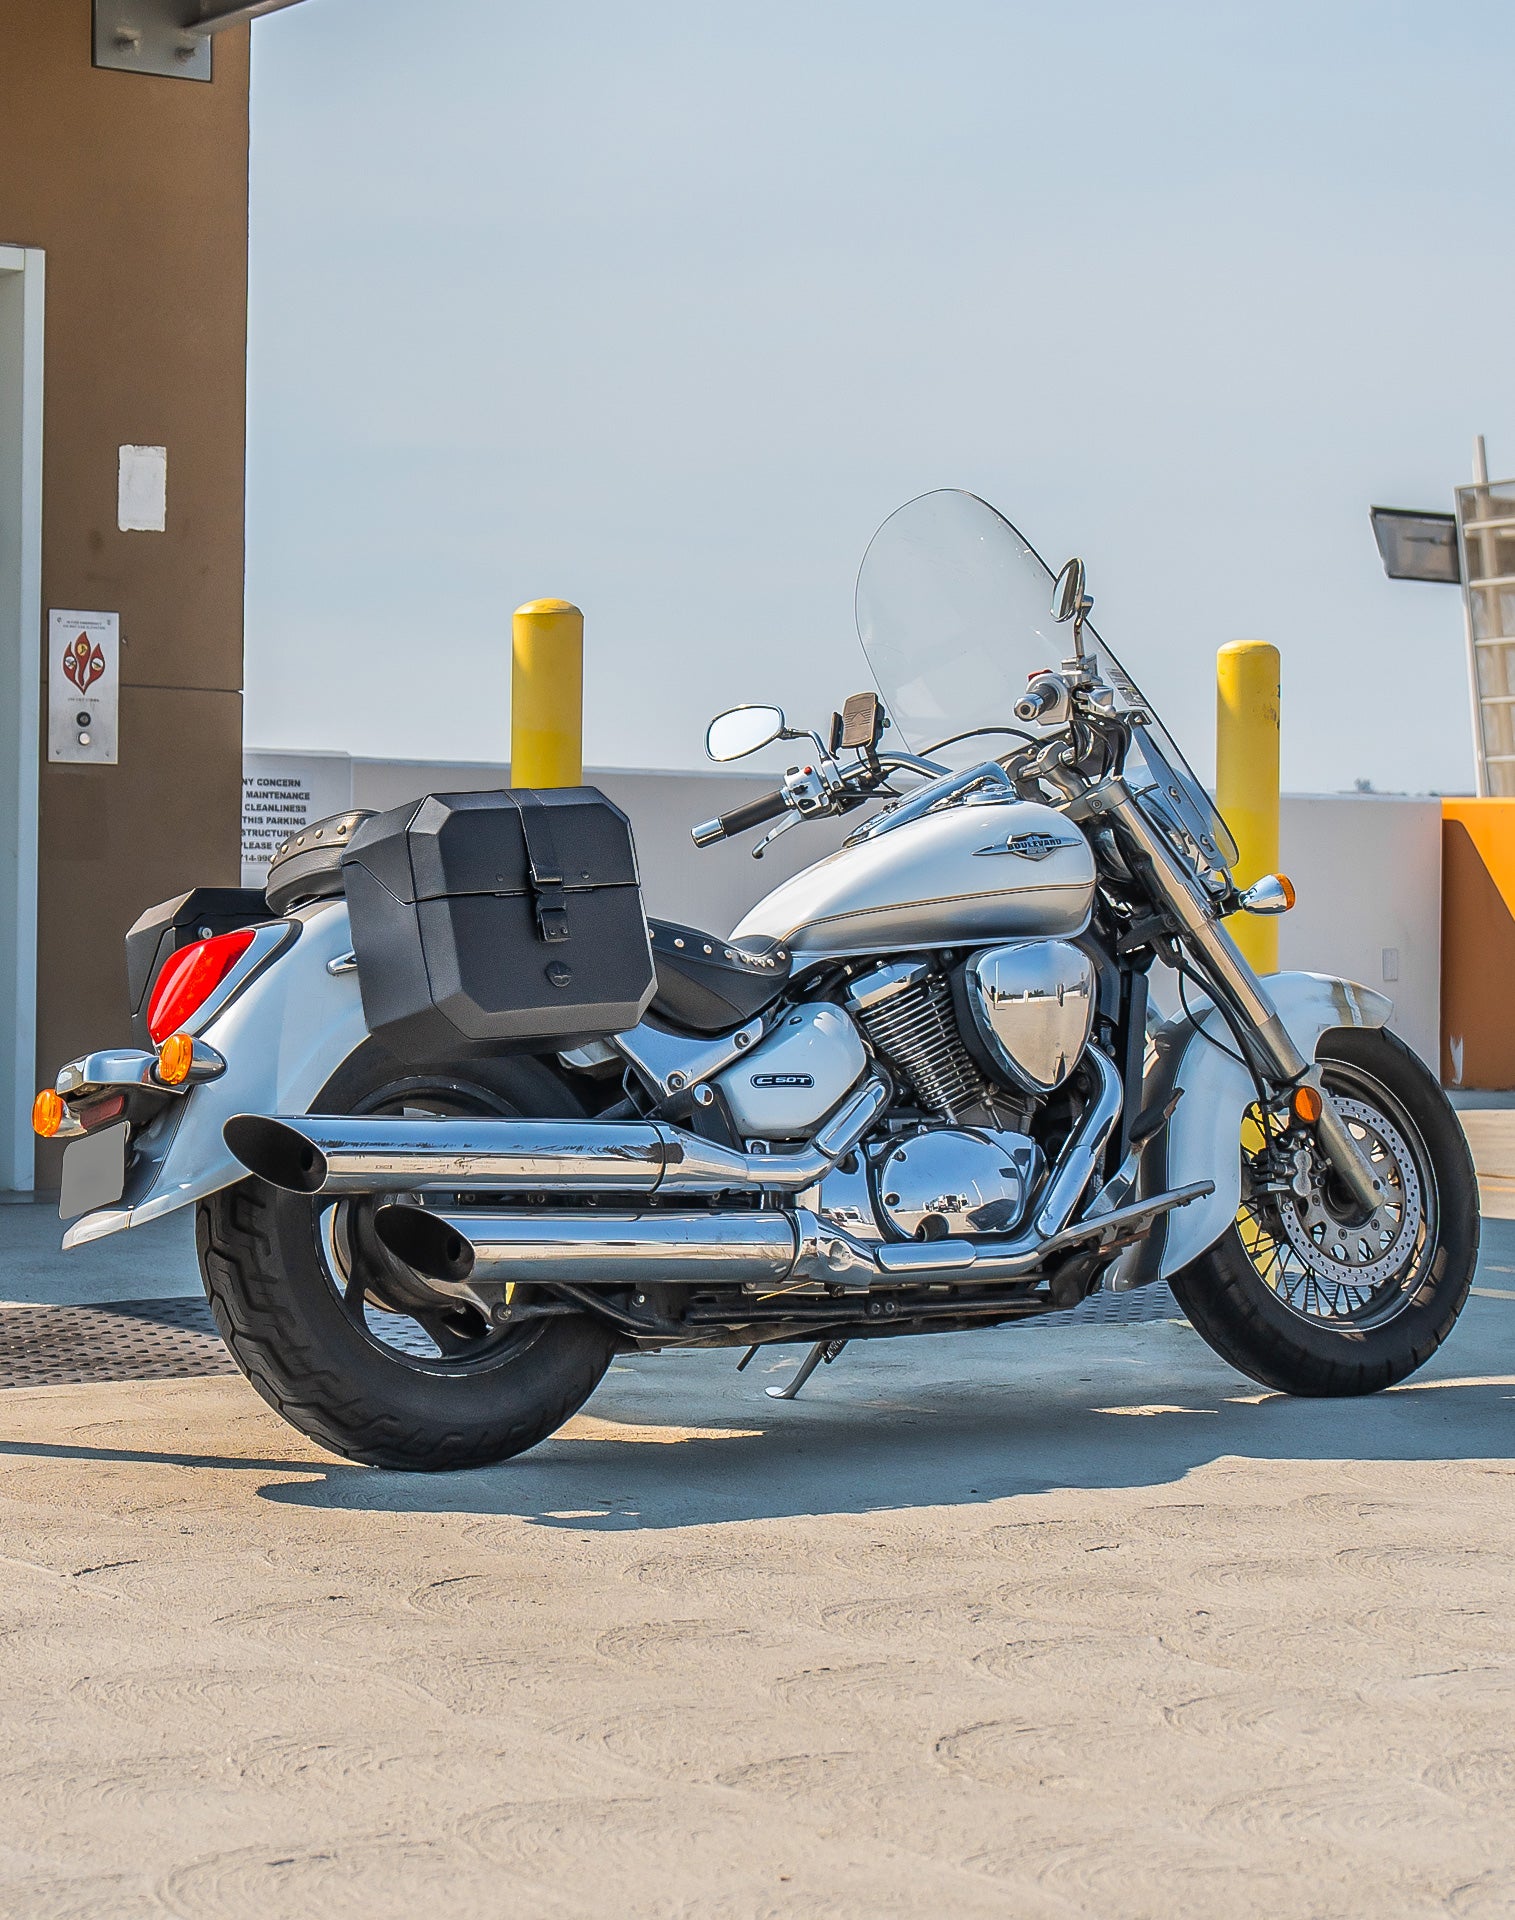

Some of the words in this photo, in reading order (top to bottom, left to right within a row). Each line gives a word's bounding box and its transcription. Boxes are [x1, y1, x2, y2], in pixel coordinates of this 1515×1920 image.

[242, 778, 254, 786] NY
[256, 778, 301, 787] CONCERN
[246, 791, 310, 800] MAINTENANCE
[244, 803, 307, 813] CLEANLINESS
[242, 816, 264, 824] THIS
[266, 816, 306, 825] PARKING
[241, 841, 272, 850] LEASE
[1007, 838, 1062, 850] BOULEVARD
